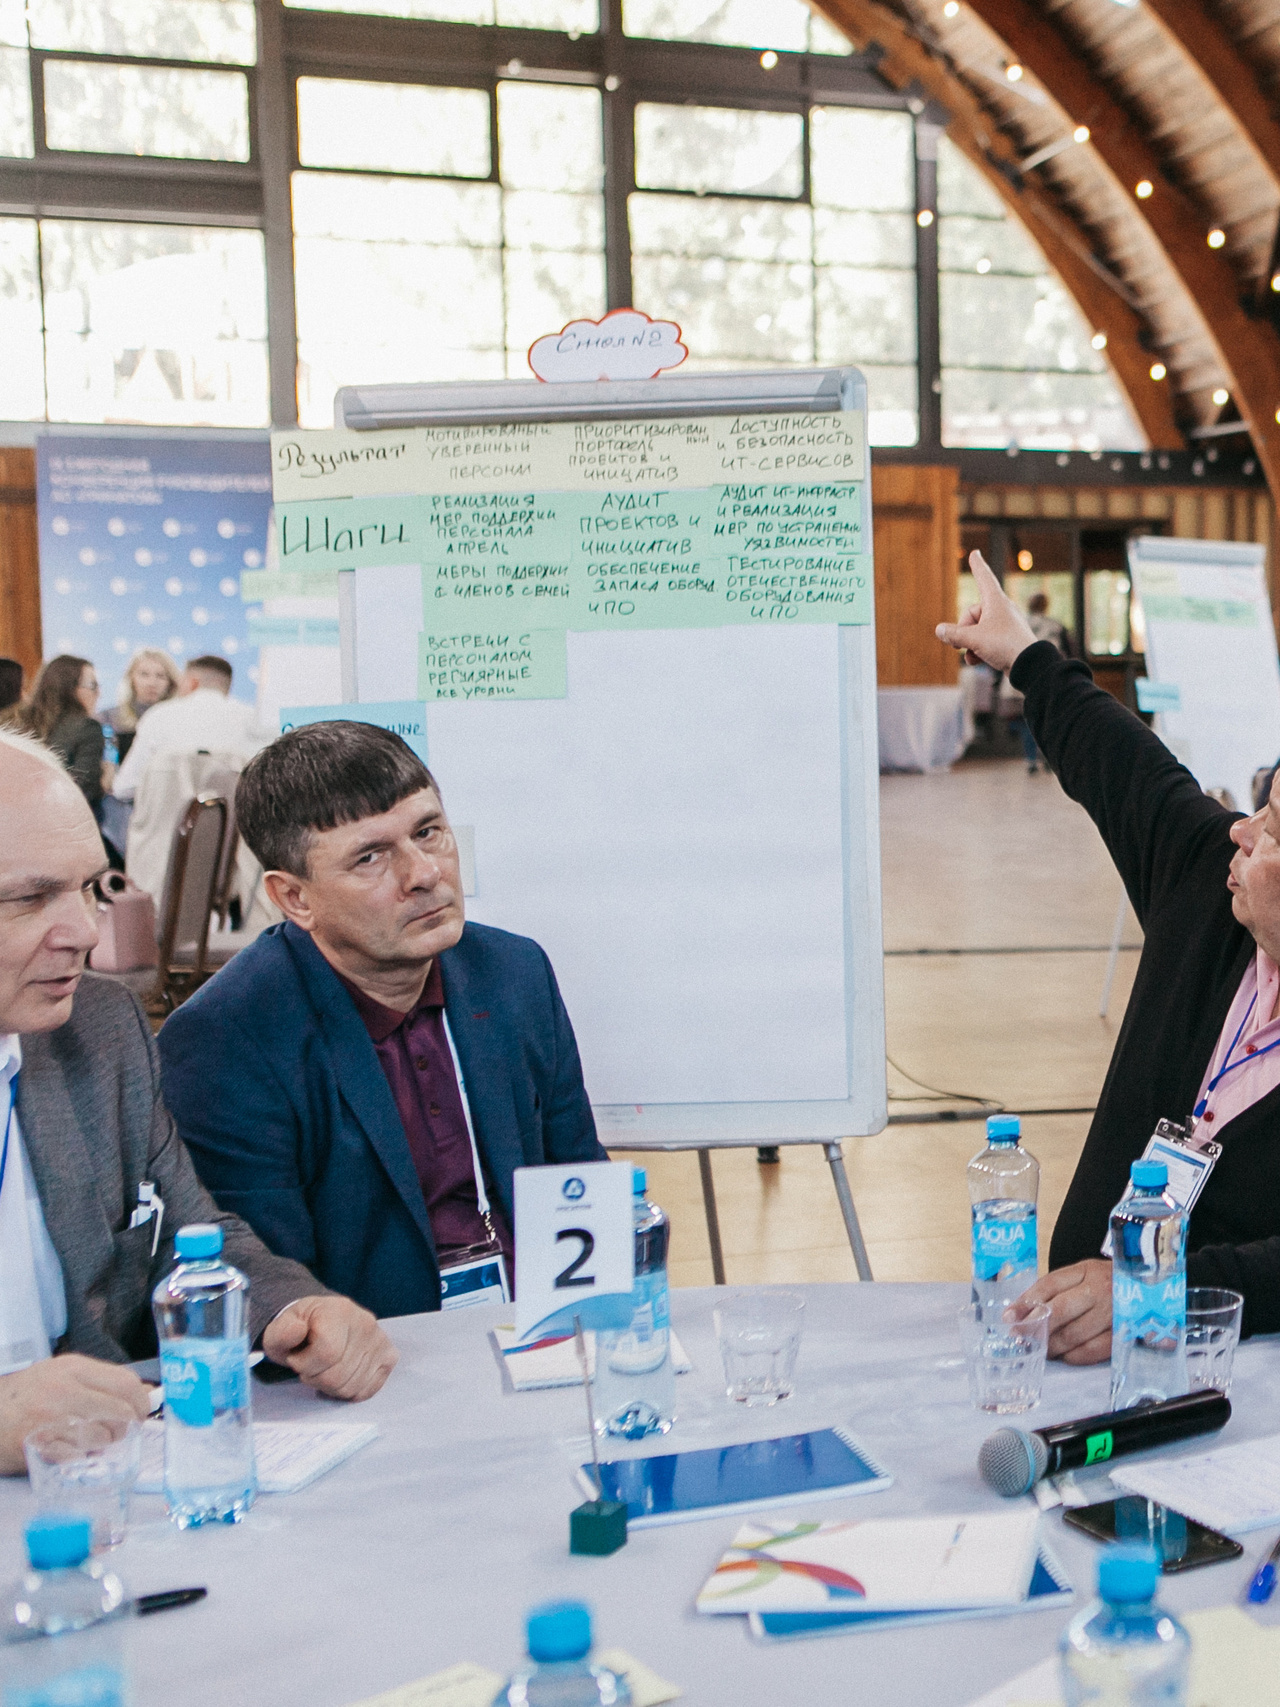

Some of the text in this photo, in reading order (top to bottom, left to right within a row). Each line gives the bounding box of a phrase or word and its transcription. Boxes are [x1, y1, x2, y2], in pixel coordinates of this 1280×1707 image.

[279, 442, 405, 478] Результат
[720, 484, 767, 501] АУДИТ
[601, 491, 669, 512] АУДИТ
[580, 514, 678, 533] ПРОЕКТОВ
[283, 516, 410, 555] Шаги
[437, 564, 486, 579] МЕРЫ
[587, 562, 701, 576] ОБЕСПЕЧЕНИЕ
[727, 556, 855, 572] ТЕСТИРОВАНИЕ
[727, 575, 866, 589] ОТЕЧЕСТВЕННОГО
[604, 600, 635, 615] ПО
[428, 634, 509, 650] ВСТРЕЧИ
[426, 651, 532, 667] ПЕРСОНАЛОМ
[429, 666, 532, 685] РЕГУЛЯРНЫЕ
[978, 1223, 1026, 1246] AQUA
[554, 1227, 596, 1291] 2
